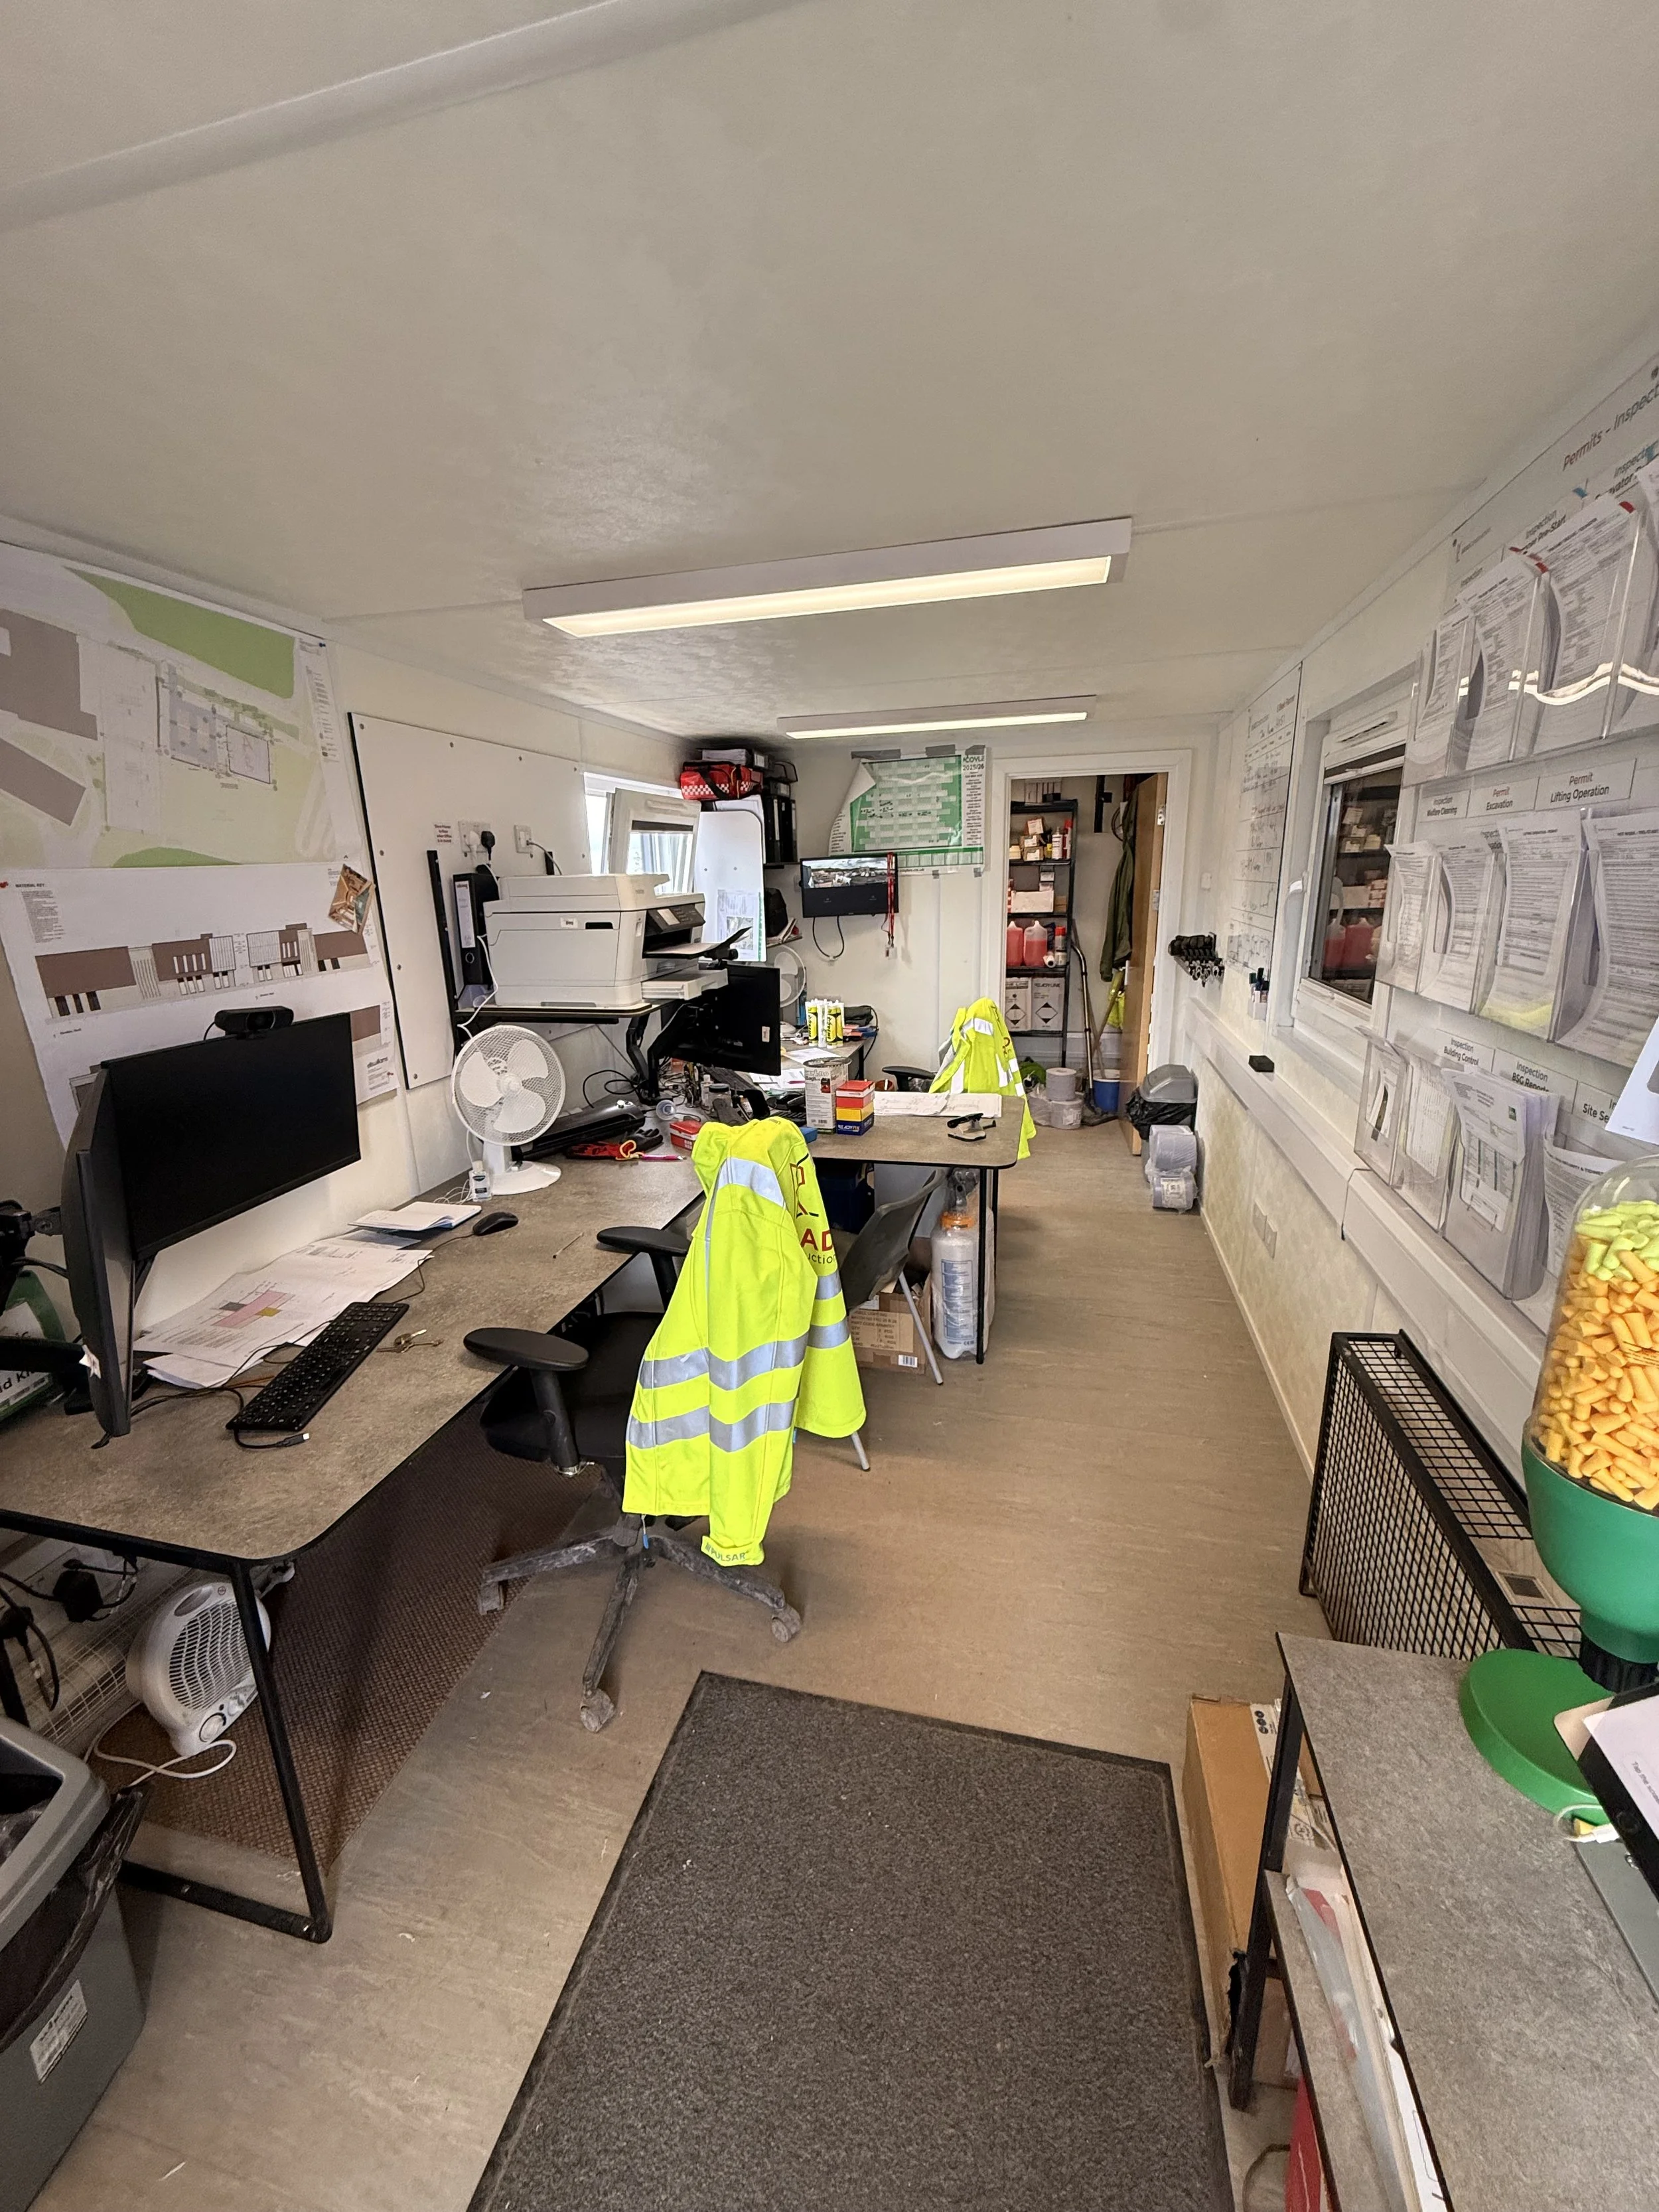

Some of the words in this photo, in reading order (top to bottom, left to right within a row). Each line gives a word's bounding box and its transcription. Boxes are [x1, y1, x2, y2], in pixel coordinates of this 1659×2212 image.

[1563, 430, 1603, 472] Permits
[1569, 773, 1593, 786] Permit
[1492, 786, 1510, 797] Permit
[1550, 790, 1571, 803] Lifting
[1572, 786, 1610, 800] Operation
[1486, 800, 1513, 810] Excavation
[1451, 1037, 1474, 1053] Inspection
[1444, 1046, 1461, 1061] Building
[1461, 1053, 1479, 1066] Control
[1516, 1062, 1548, 1082] Inspection
[1582, 1103, 1598, 1118] Site
